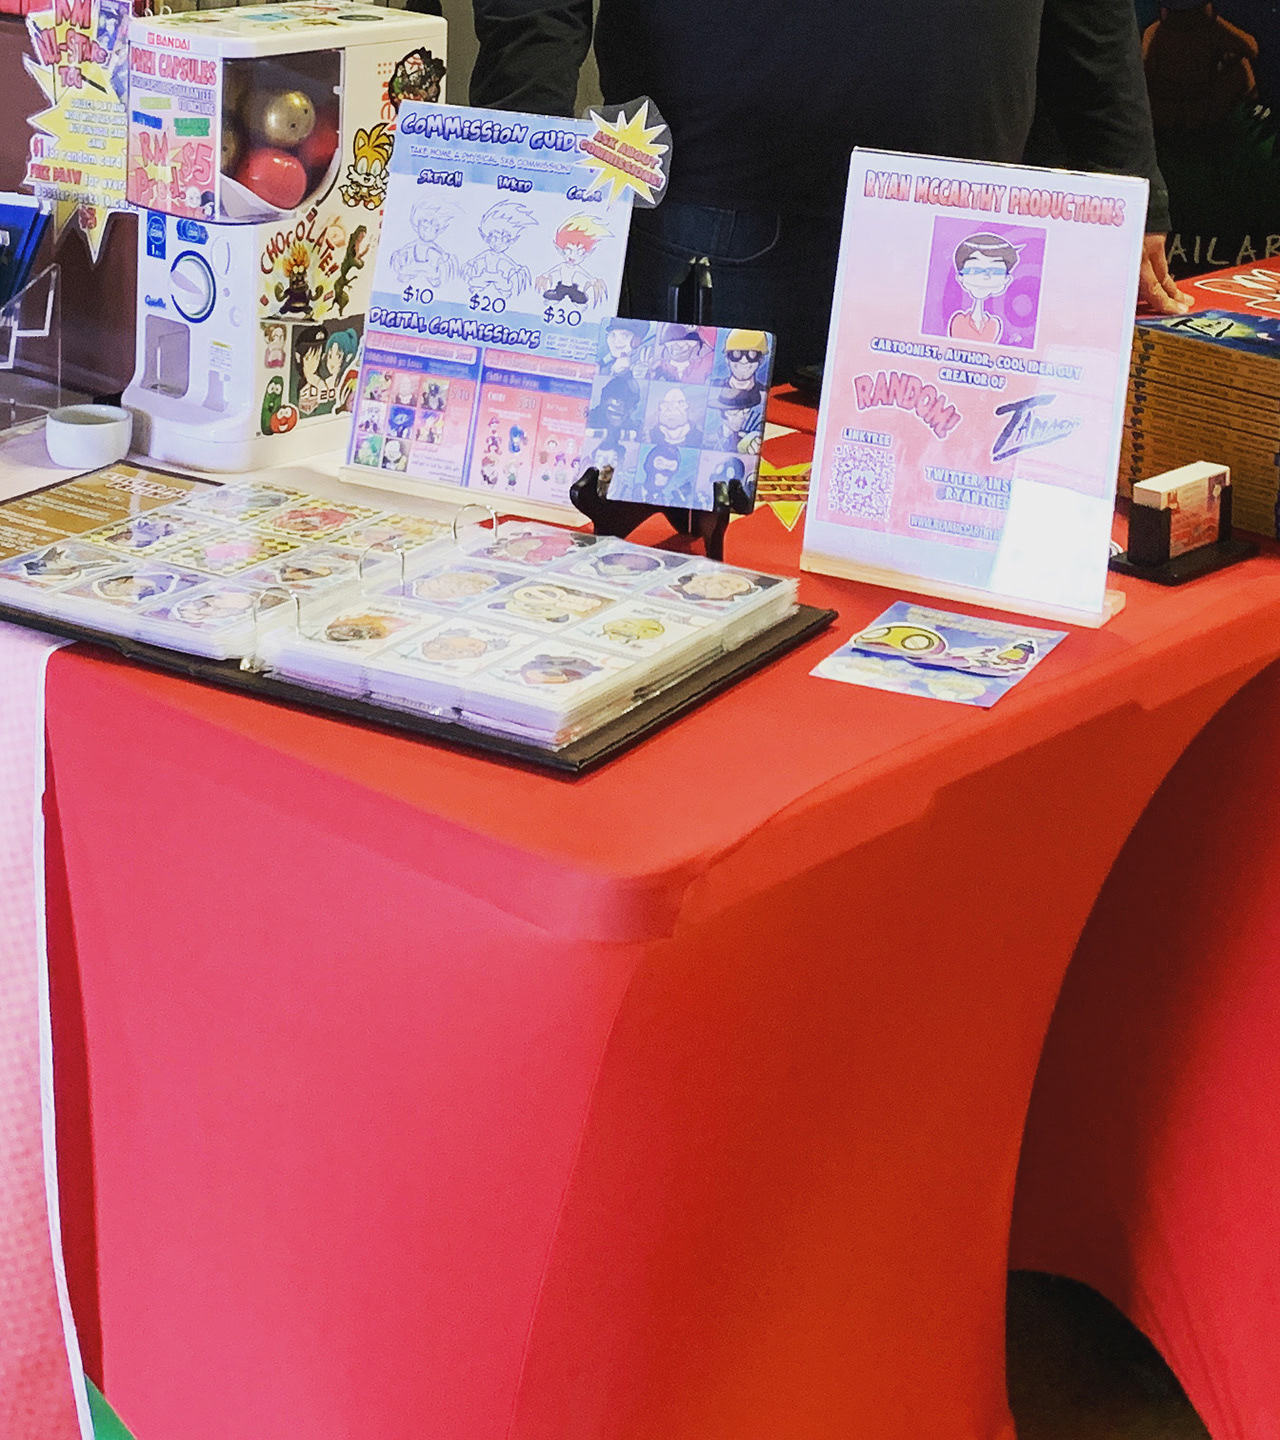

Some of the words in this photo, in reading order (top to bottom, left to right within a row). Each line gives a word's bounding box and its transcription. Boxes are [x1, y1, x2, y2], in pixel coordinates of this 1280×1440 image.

[156, 34, 190, 50] BANDAI
[159, 54, 217, 86] CAPSULES
[140, 132, 169, 167] RM
[410, 145, 429, 157] TAKE
[430, 148, 453, 160] HOME
[592, 130, 618, 150] ASK
[617, 141, 660, 168] ABOUT
[180, 142, 214, 184] $5
[417, 169, 463, 188] SKETCH
[497, 175, 533, 193] INKED
[864, 169, 913, 202] RYAN
[914, 175, 1007, 214] MCCARTHY
[1008, 186, 1126, 228] PRODUCTIONS
[402, 285, 434, 305] $10
[470, 293, 506, 314] $20
[369, 307, 427, 333] DIGITAL
[543, 306, 582, 327] $30
[870, 337, 943, 361] CARTOONIST,
[945, 348, 994, 369] AUTHOR,
[996, 356, 1025, 372] COOL
[1027, 360, 1055, 377] IDEA
[1056, 363, 1082, 380] GUY
[939, 367, 989, 387] CREATOR
[989, 373, 1007, 390] OF
[854, 371, 962, 439] RANDOM!
[843, 428, 892, 447] LINKTREE
[925, 466, 1014, 492] TWITTER/INS
